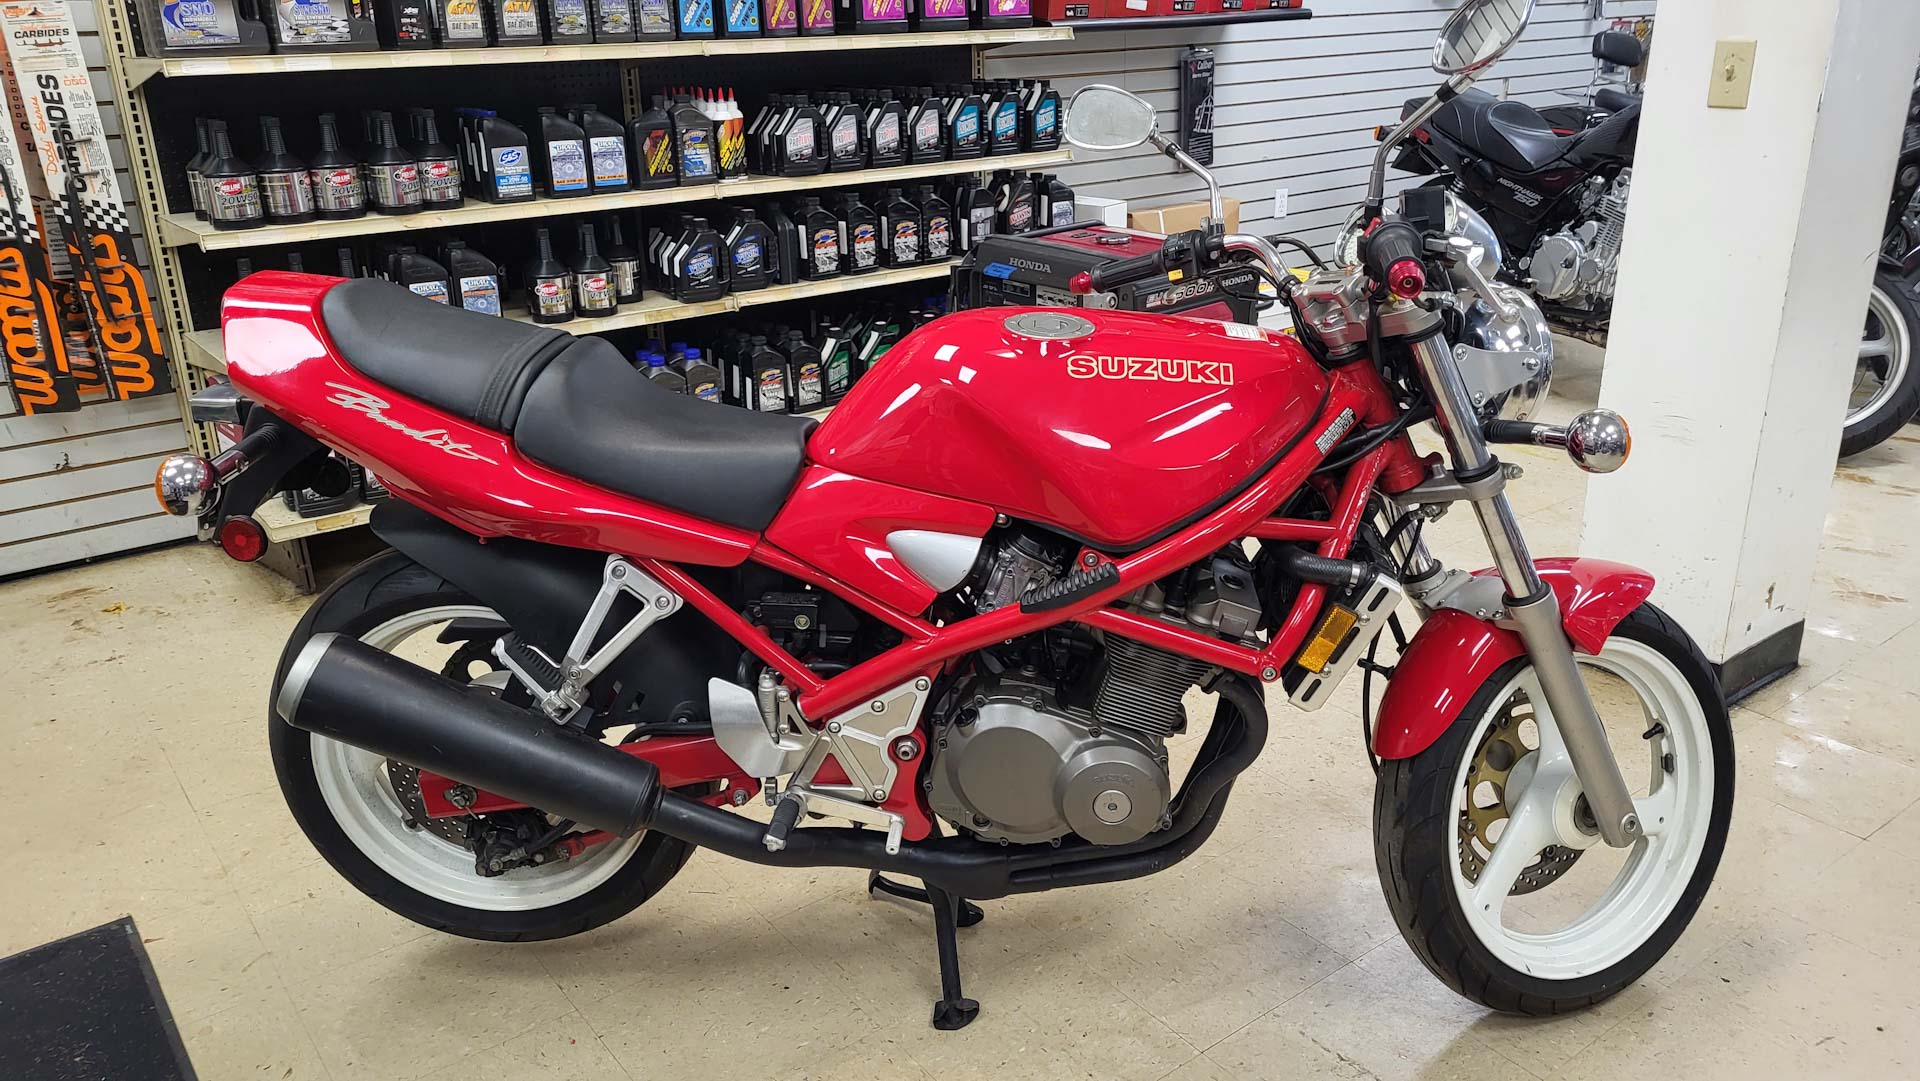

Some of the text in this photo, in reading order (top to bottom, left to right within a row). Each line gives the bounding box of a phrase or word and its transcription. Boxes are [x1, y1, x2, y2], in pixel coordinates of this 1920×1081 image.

[181, 2, 215, 16] SNO
[451, 4, 475, 14] ATV
[506, 2, 532, 12] ATV
[14, 28, 70, 39] CARBIDES
[501, 151, 519, 162] S&S
[1497, 177, 1543, 201] NIGHTHAWK
[222, 192, 257, 206] 20W50
[1513, 191, 1539, 207] 750
[1008, 257, 1052, 273] HONDA
[1221, 273, 1254, 288] HONDA
[1067, 355, 1234, 386] SUZUKI
[325, 381, 499, 466] Bandit
